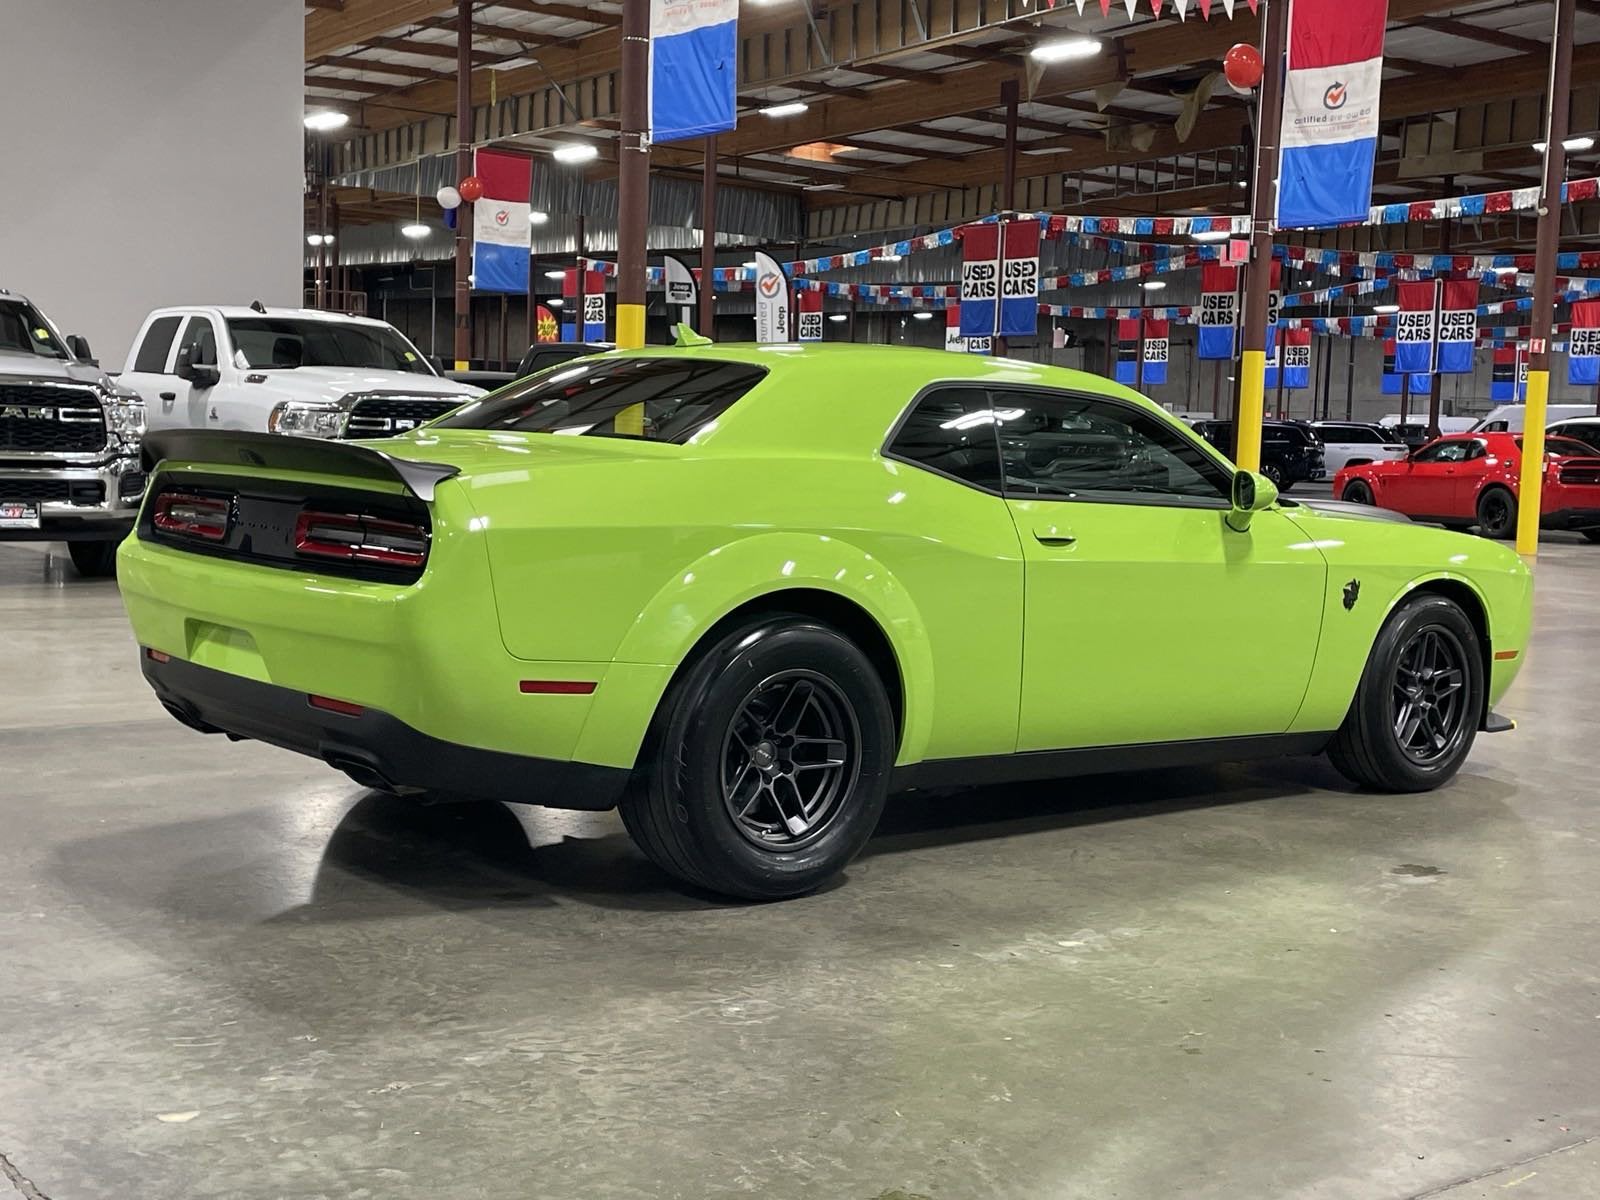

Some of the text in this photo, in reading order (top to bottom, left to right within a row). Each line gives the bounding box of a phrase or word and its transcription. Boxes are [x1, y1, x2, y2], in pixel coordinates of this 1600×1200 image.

[1294, 115, 1327, 125] ctified
[964, 264, 995, 280] USED
[1005, 261, 1036, 278] USED
[963, 281, 996, 298] CARS
[1003, 279, 1036, 295] CARS
[1203, 295, 1234, 309] USED
[776, 306, 786, 334] Jeep
[801, 315, 821, 325] USED
[1202, 310, 1234, 325] CARS
[1399, 313, 1431, 327] USED
[1441, 312, 1475, 326] USED
[1397, 327, 1431, 341] CARS
[1440, 326, 1474, 340] CARS
[1287, 347, 1309, 356] USED
[1286, 357, 1309, 366] CARS
